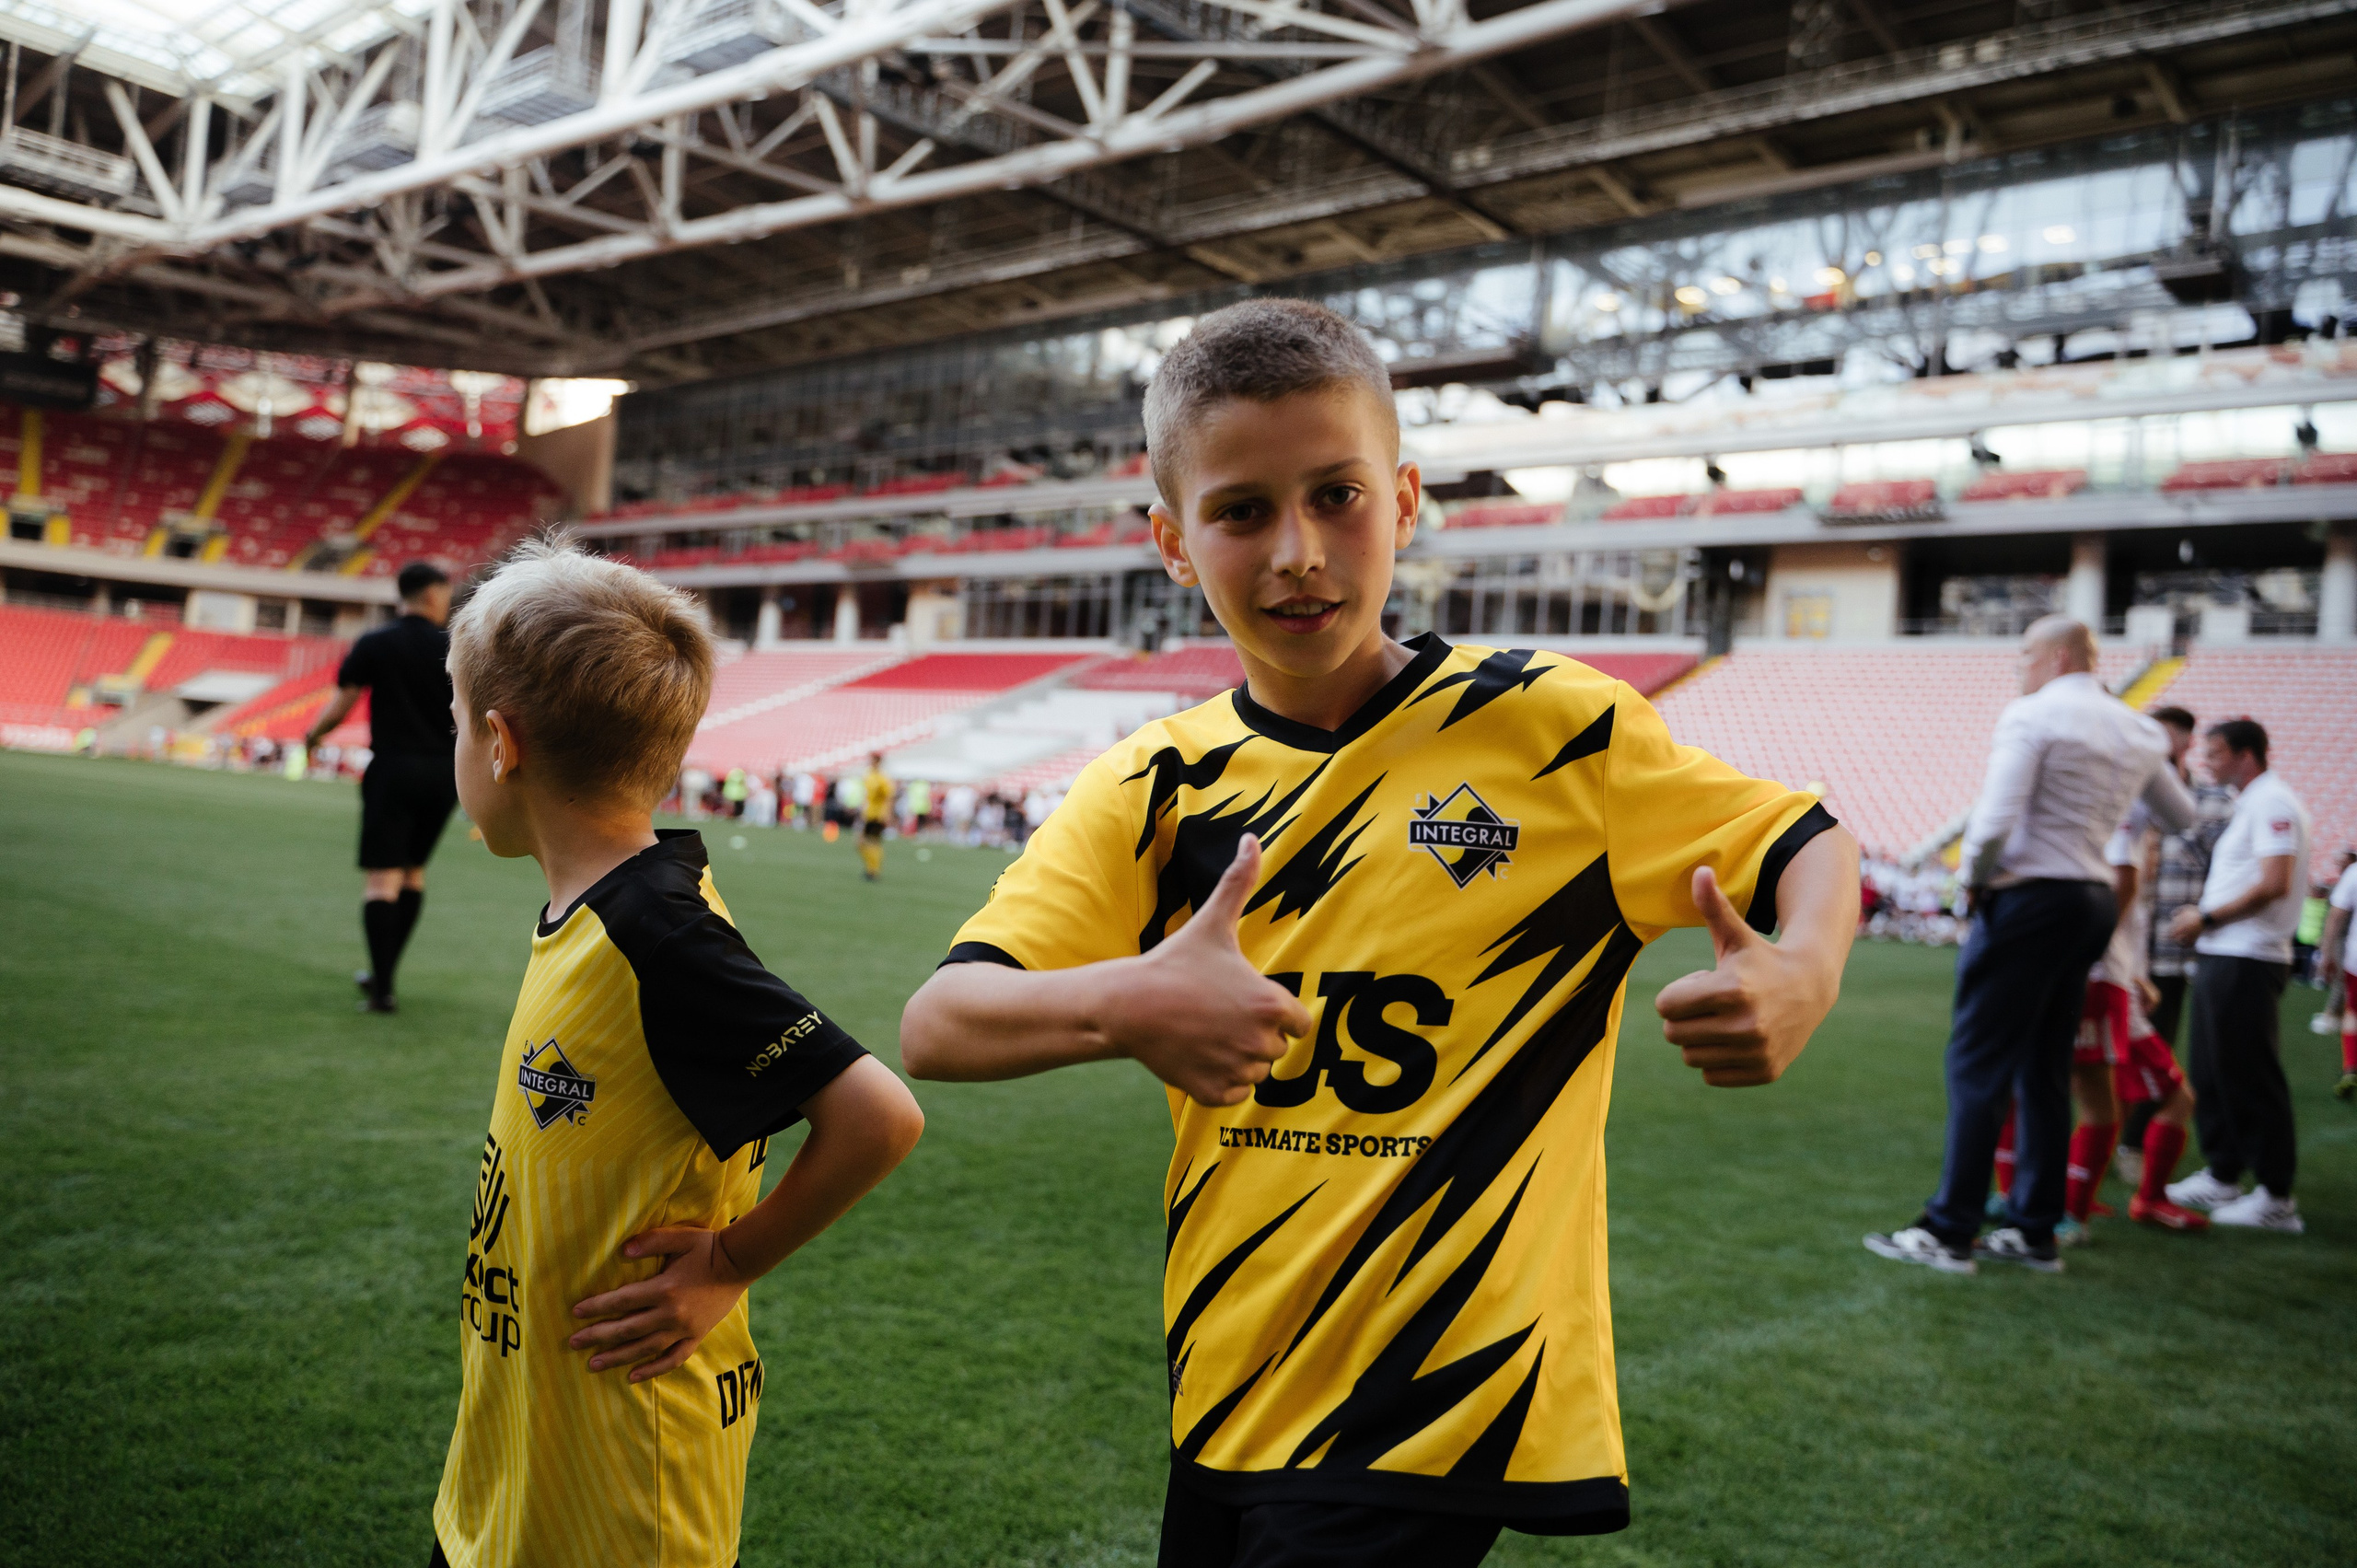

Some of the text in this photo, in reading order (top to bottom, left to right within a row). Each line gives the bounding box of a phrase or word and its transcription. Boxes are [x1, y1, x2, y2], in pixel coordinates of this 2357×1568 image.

[1415, 824, 1512, 846] INTEGRAL
[1500, 868, 1508, 879] C
[745, 1010, 823, 1077] NOBAREY
[520, 1068, 589, 1098] INTEGRAL
[577, 1116, 586, 1126] C
[1220, 1126, 1434, 1157] LTIMATE SPORTS
[461, 1294, 520, 1358] roup
